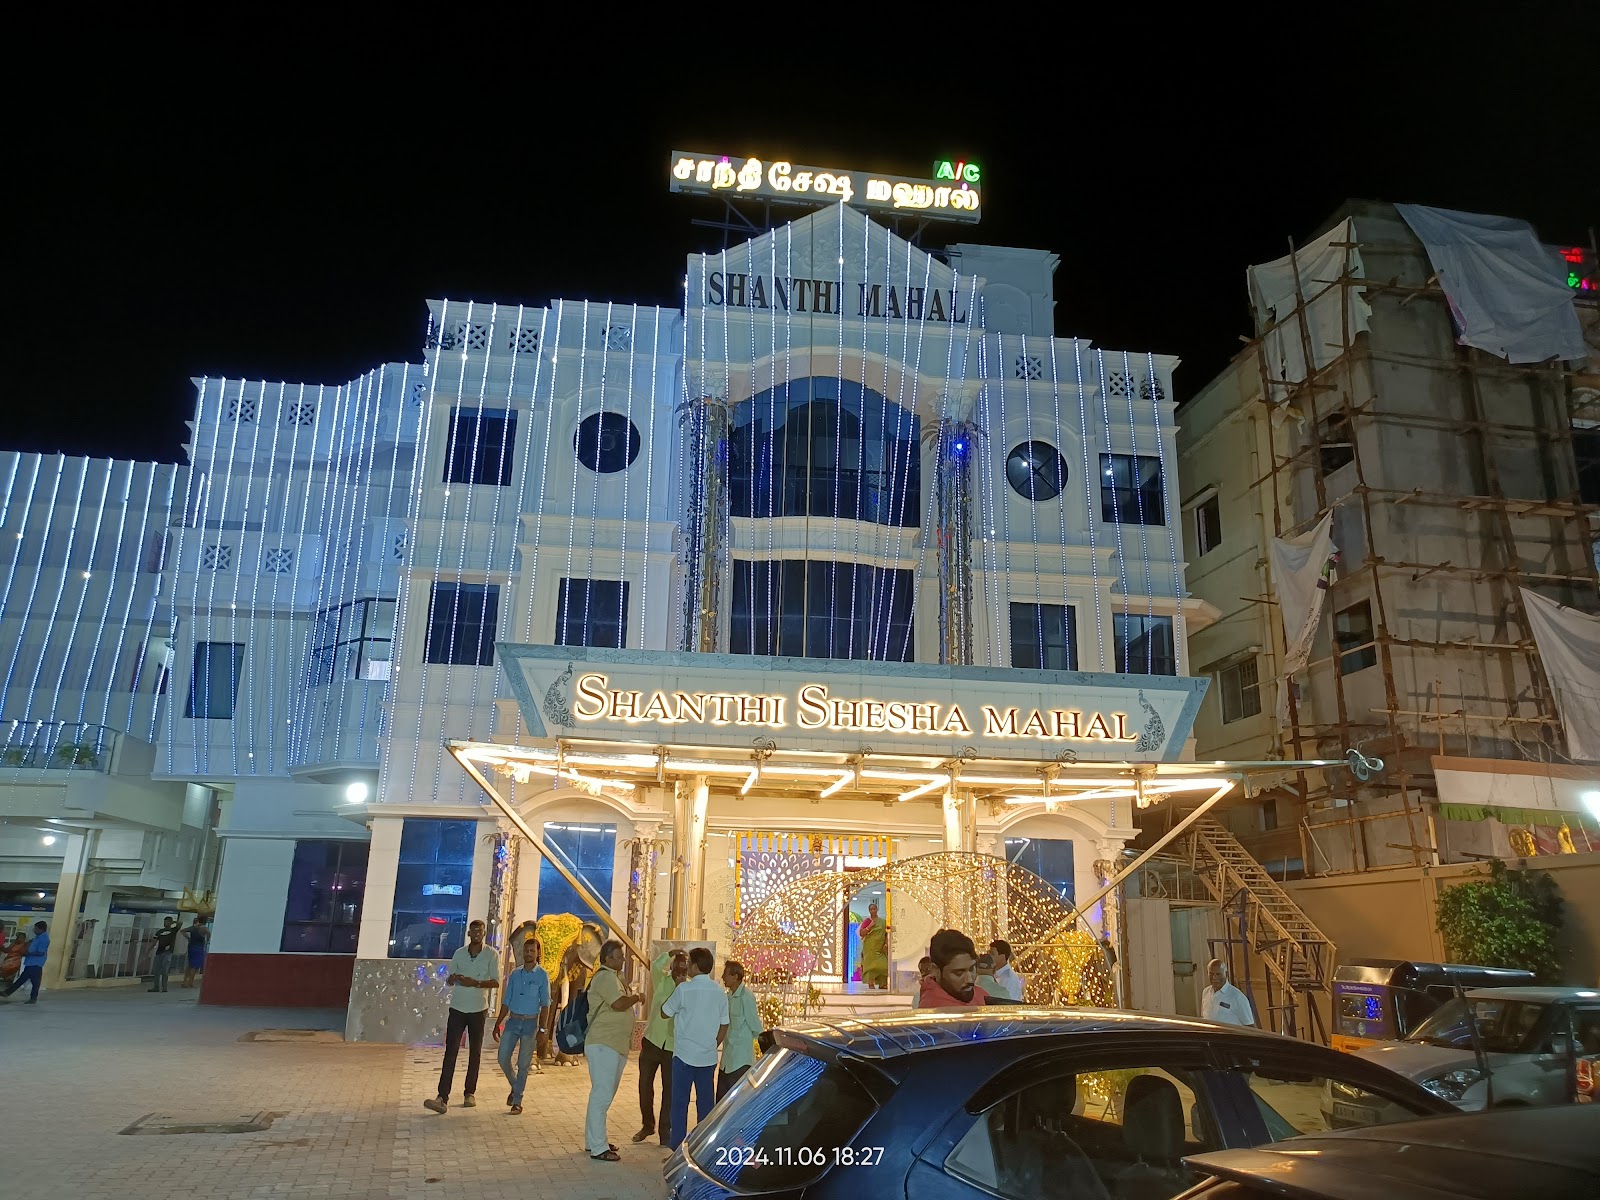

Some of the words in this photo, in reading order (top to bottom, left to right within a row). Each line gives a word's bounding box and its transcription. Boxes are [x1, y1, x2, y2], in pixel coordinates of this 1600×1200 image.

[673, 156, 763, 192] சாந்தி
[936, 161, 980, 182] A/C
[708, 271, 844, 314] SHANTHI
[857, 283, 966, 324] MAHAL
[981, 705, 1138, 743] MAHAL
